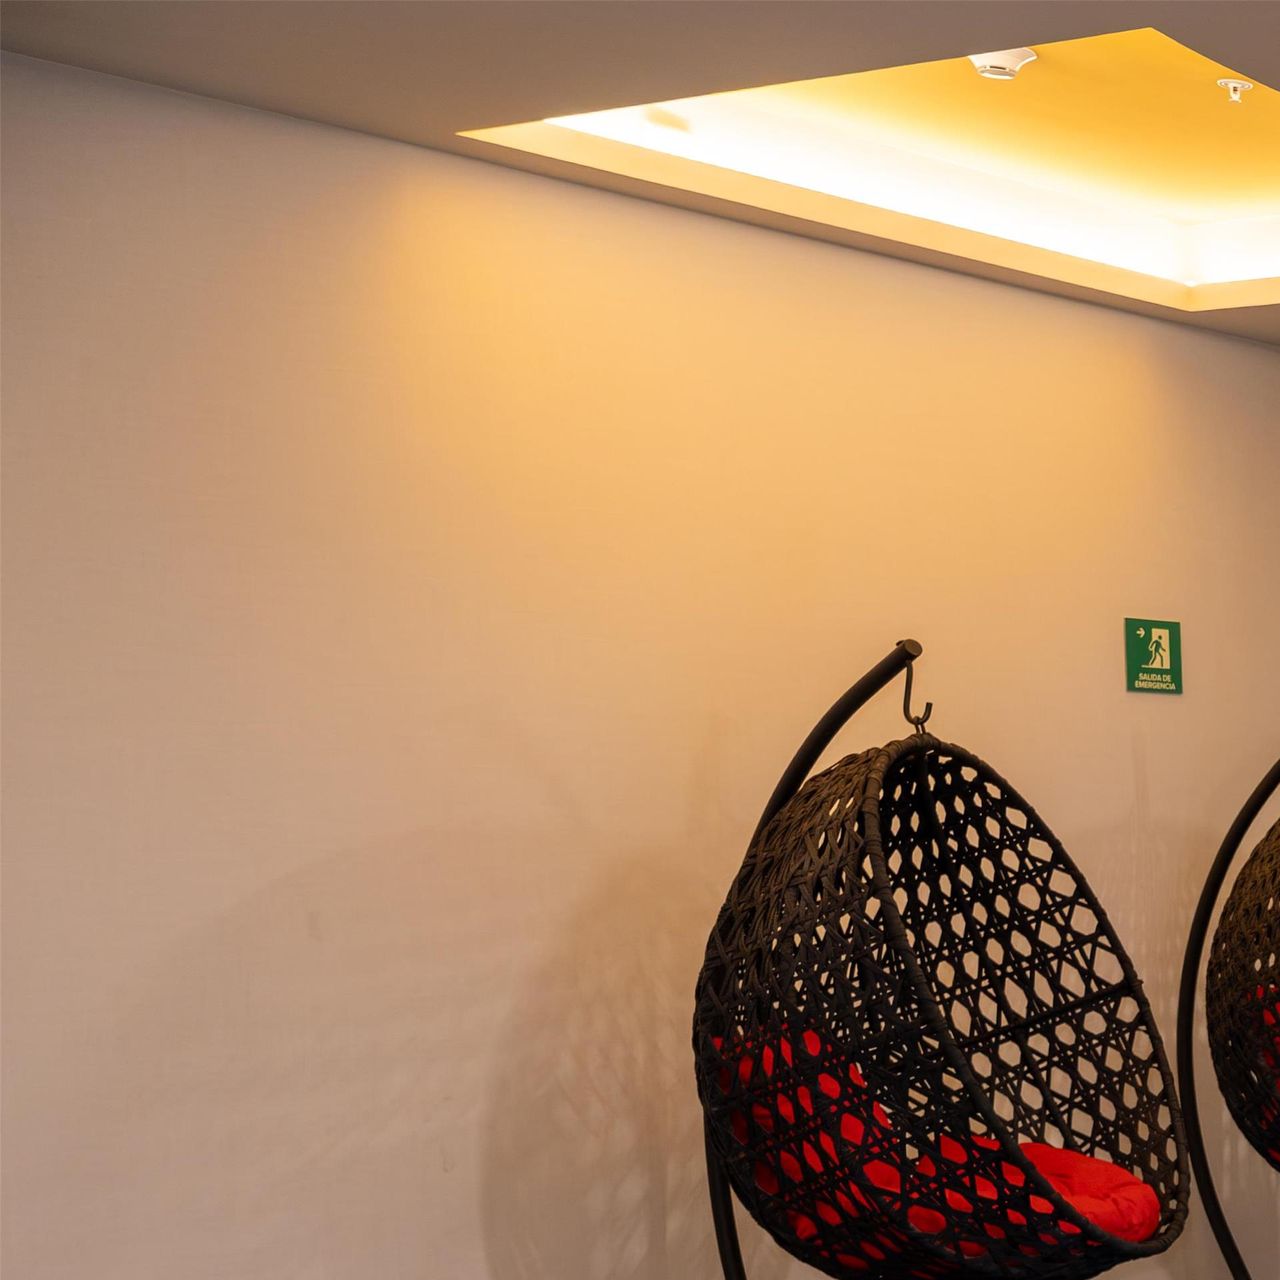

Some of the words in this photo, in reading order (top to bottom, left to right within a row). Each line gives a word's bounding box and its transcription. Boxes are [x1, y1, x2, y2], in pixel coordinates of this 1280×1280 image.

[1138, 672, 1162, 682] SALIDA
[1163, 675, 1172, 683] DE
[1135, 680, 1176, 690] EMERGENCIA
